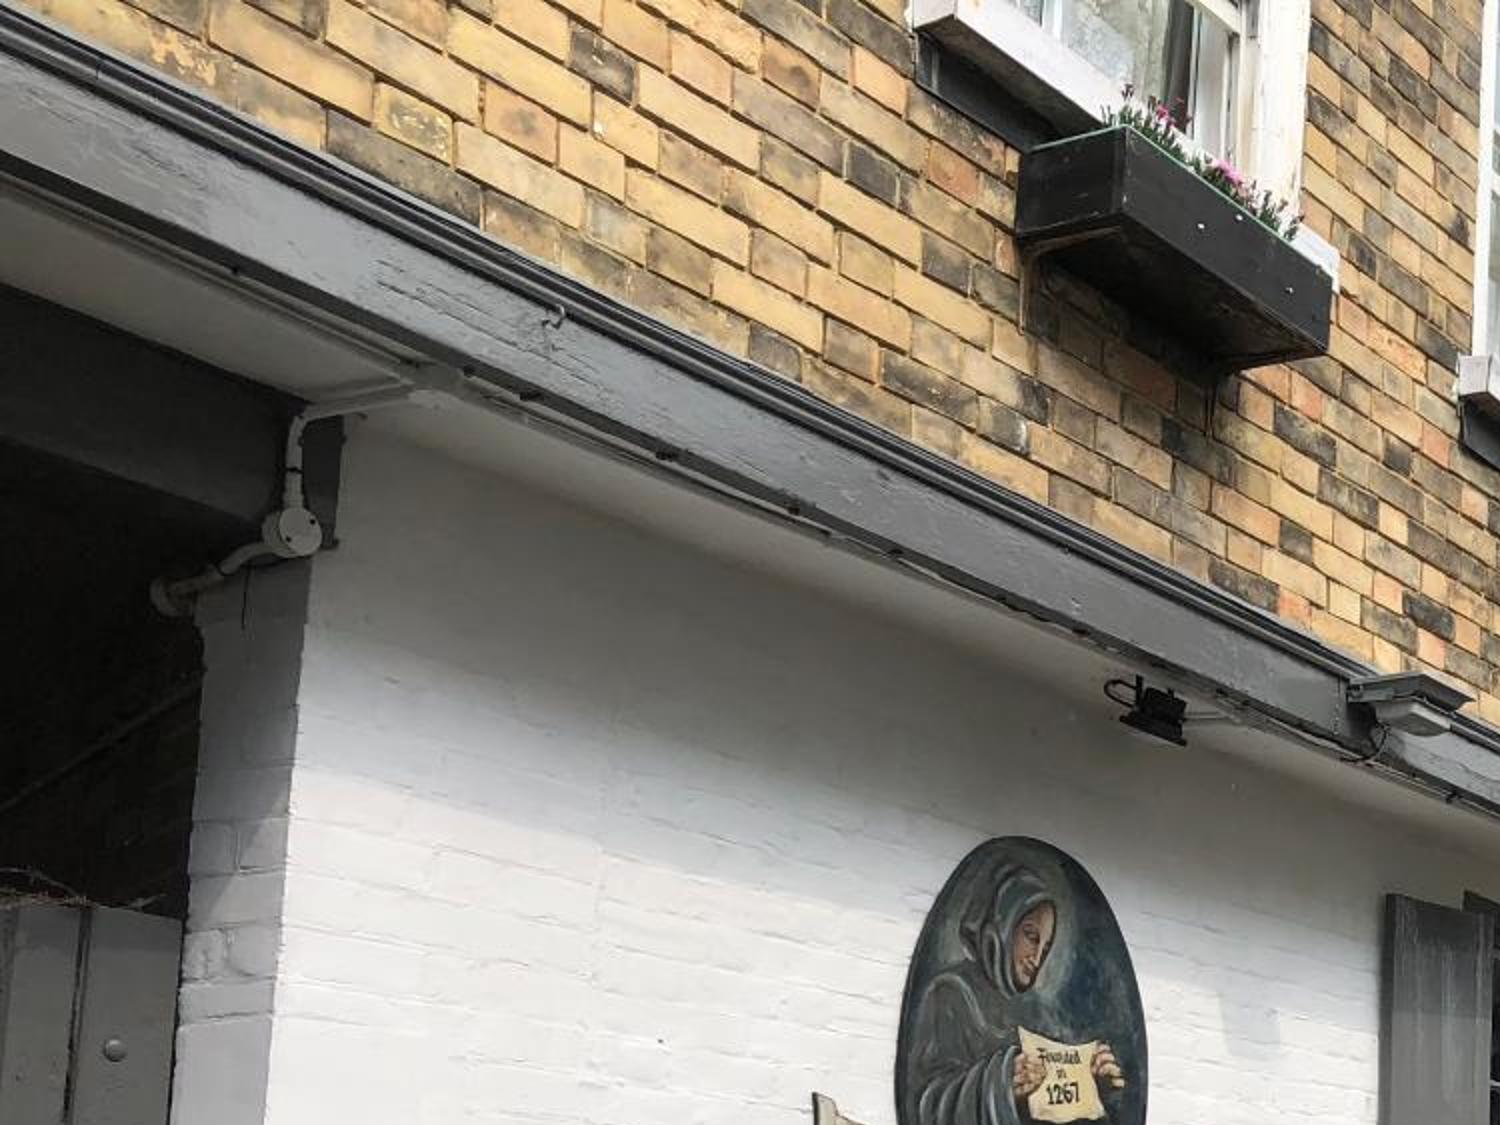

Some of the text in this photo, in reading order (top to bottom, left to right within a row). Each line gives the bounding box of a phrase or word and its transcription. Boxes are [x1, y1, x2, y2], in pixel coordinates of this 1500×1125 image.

[1037, 1047, 1082, 1066] Founded
[1056, 1065, 1067, 1079] in
[1046, 1081, 1080, 1105] 1267
